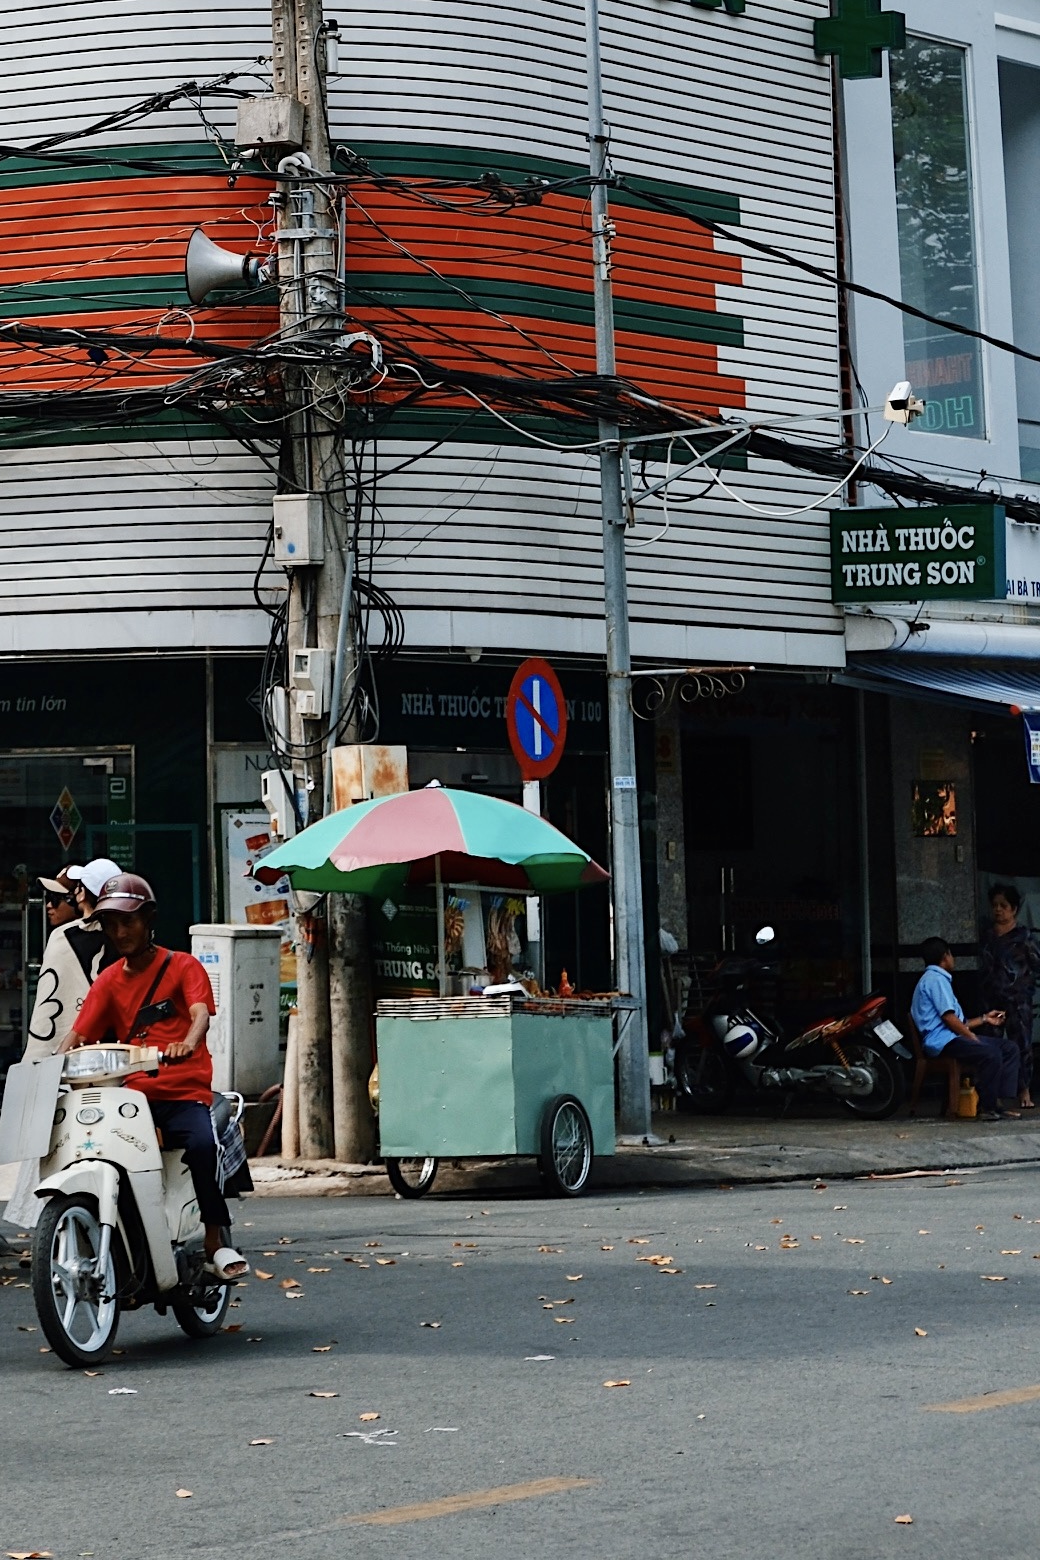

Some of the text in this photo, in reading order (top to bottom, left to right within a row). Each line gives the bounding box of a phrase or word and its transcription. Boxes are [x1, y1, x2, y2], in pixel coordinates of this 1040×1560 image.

[841, 517, 975, 553] NHÀ THUỐC
[842, 562, 921, 587] TRUNG
[16, 697, 36, 711] tin
[41, 695, 67, 711] lớn
[401, 686, 435, 717] NHÀ
[438, 686, 491, 719] THUỐC
[581, 701, 602, 722] 100
[374, 959, 423, 980] TRUNG
